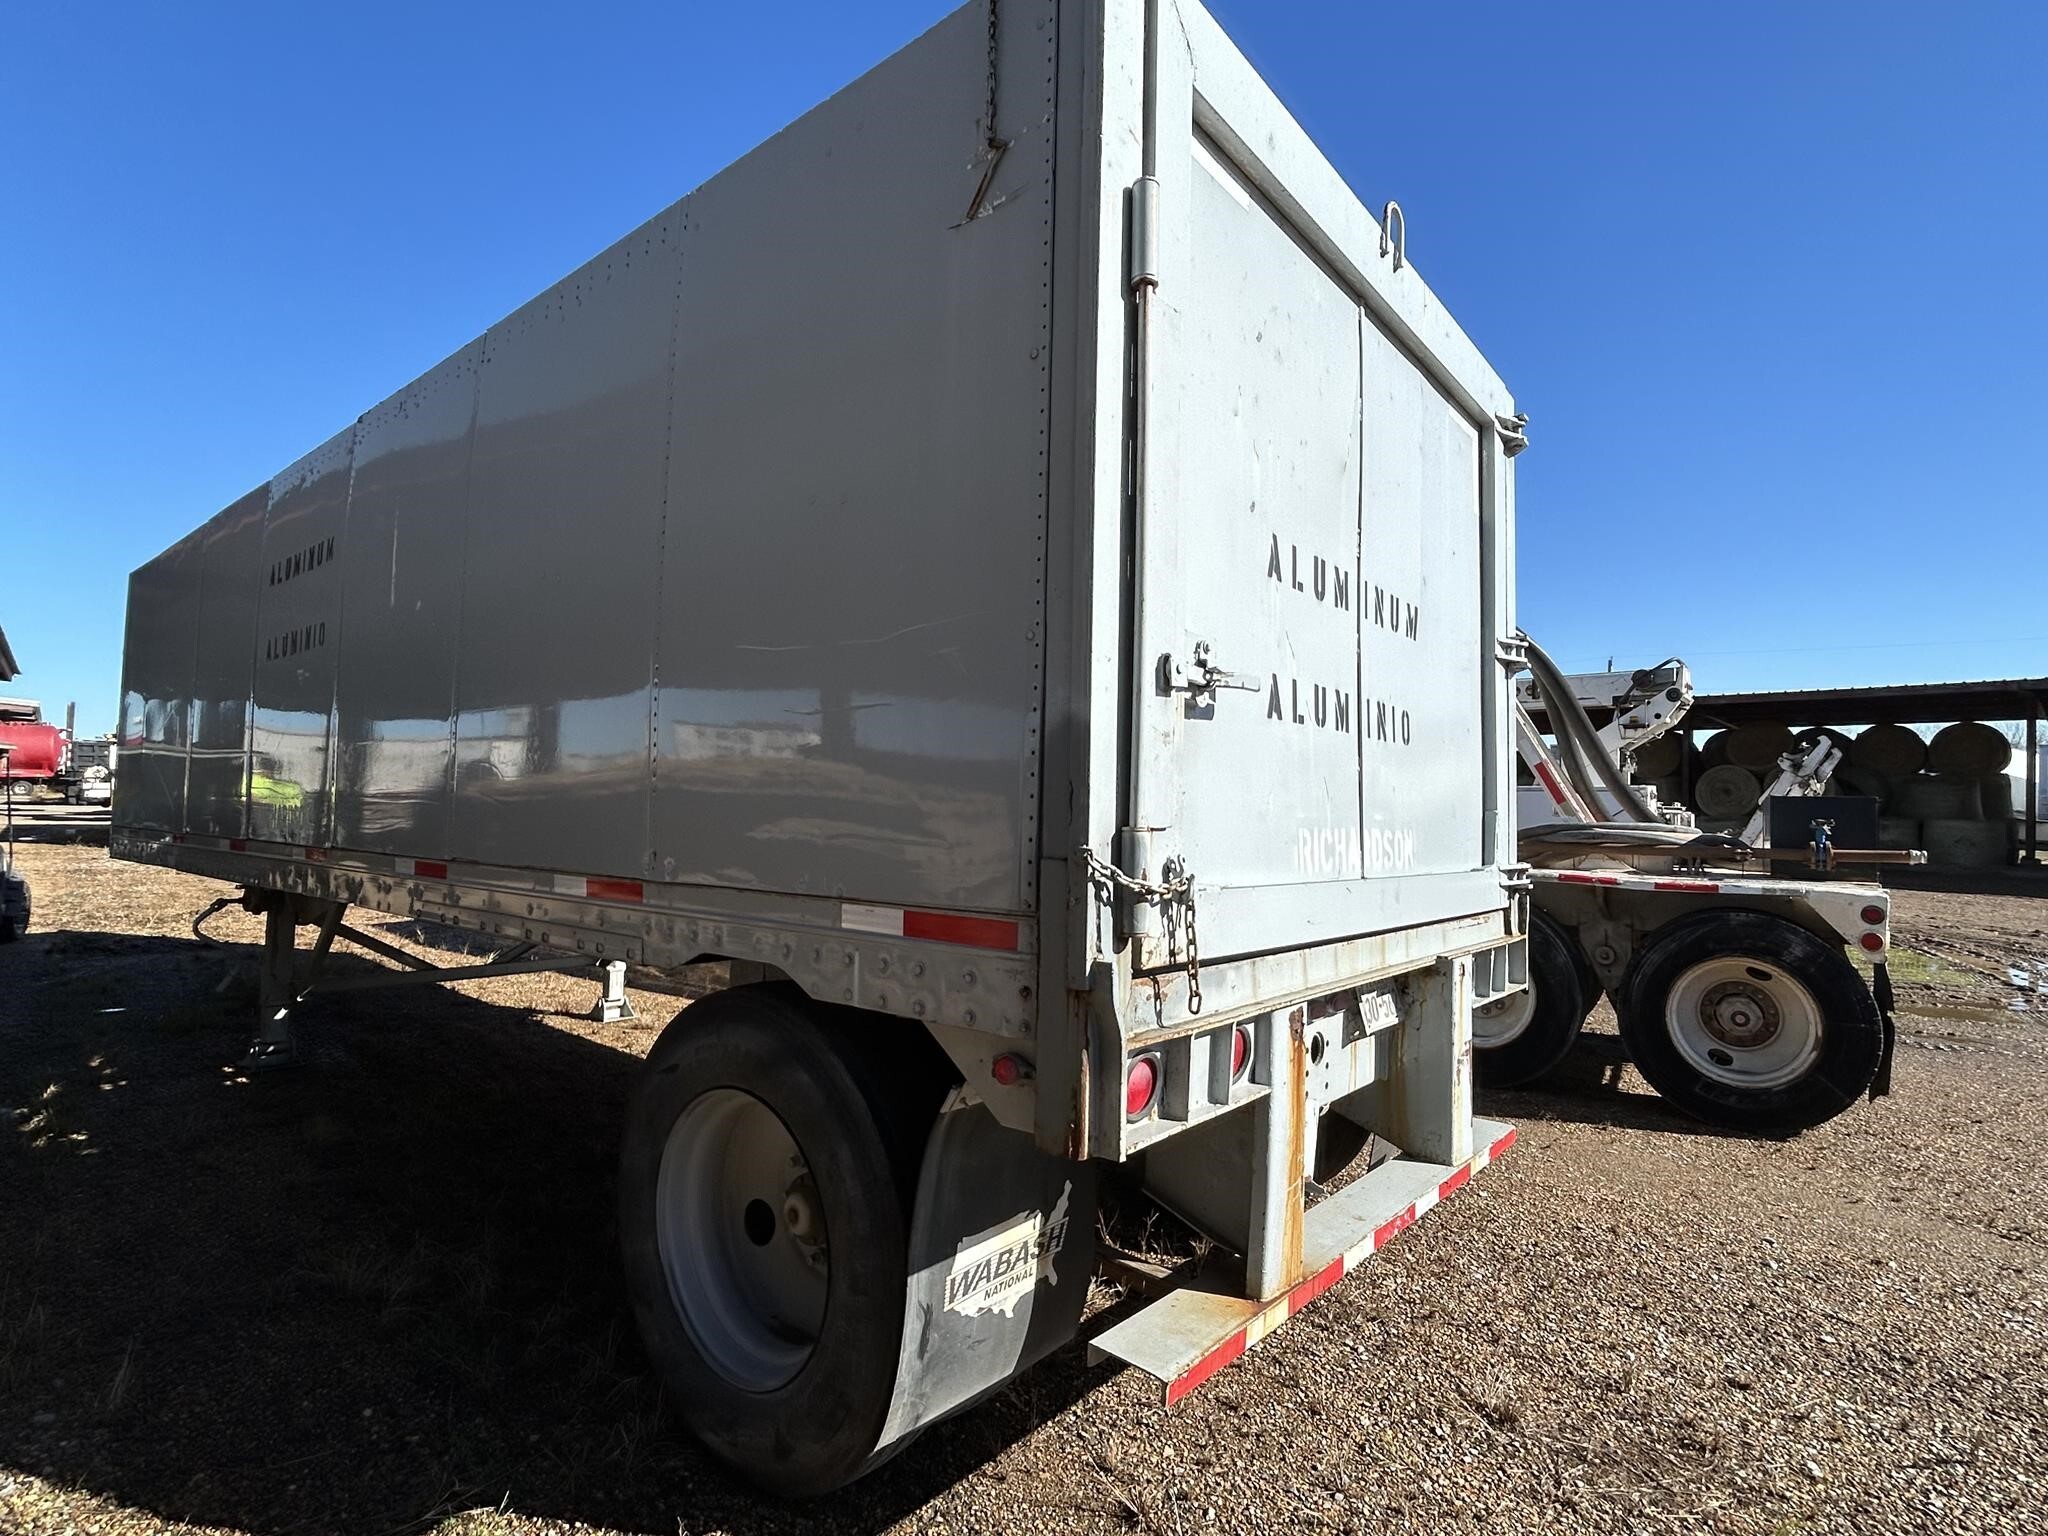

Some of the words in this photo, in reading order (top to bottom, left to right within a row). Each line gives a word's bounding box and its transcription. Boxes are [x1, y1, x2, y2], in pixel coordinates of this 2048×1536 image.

[269, 536, 335, 586] ALUMINUM
[1267, 533, 1418, 641] ALUMINUM
[266, 621, 326, 661] ALUMINIO
[1267, 673, 1411, 746] ALUMINIO
[1297, 826, 1415, 876] RICHARDSON
[949, 1221, 1065, 1304] WABASH
[984, 1267, 1033, 1301] NATIONAL
